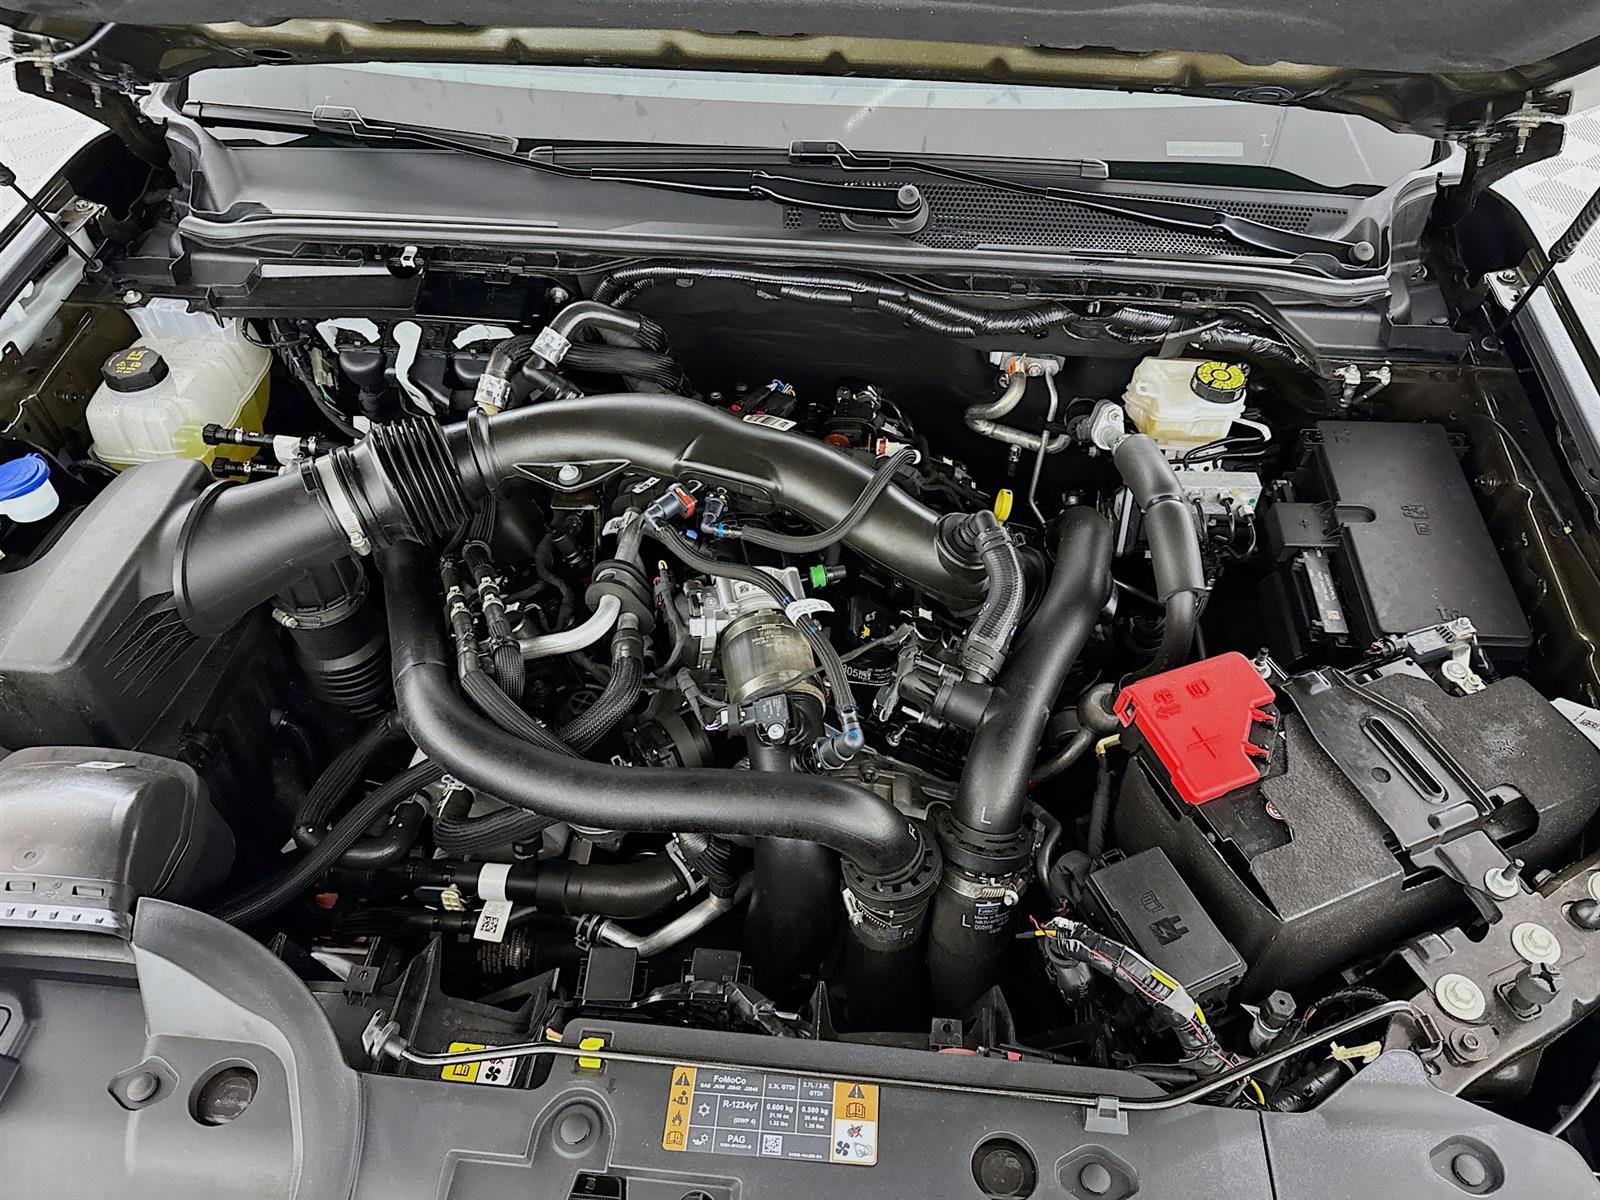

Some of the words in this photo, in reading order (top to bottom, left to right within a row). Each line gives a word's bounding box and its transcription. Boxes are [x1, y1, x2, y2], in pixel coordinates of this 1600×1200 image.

[980, 806, 992, 825] L
[962, 914, 971, 928] L
[713, 1074, 747, 1085] FoMoCo
[722, 1099, 759, 1112] R-1234yf
[766, 1103, 784, 1111] 0.600
[785, 1104, 794, 1114] kg
[820, 1107, 829, 1116] kg
[727, 1134, 746, 1144] PAG
